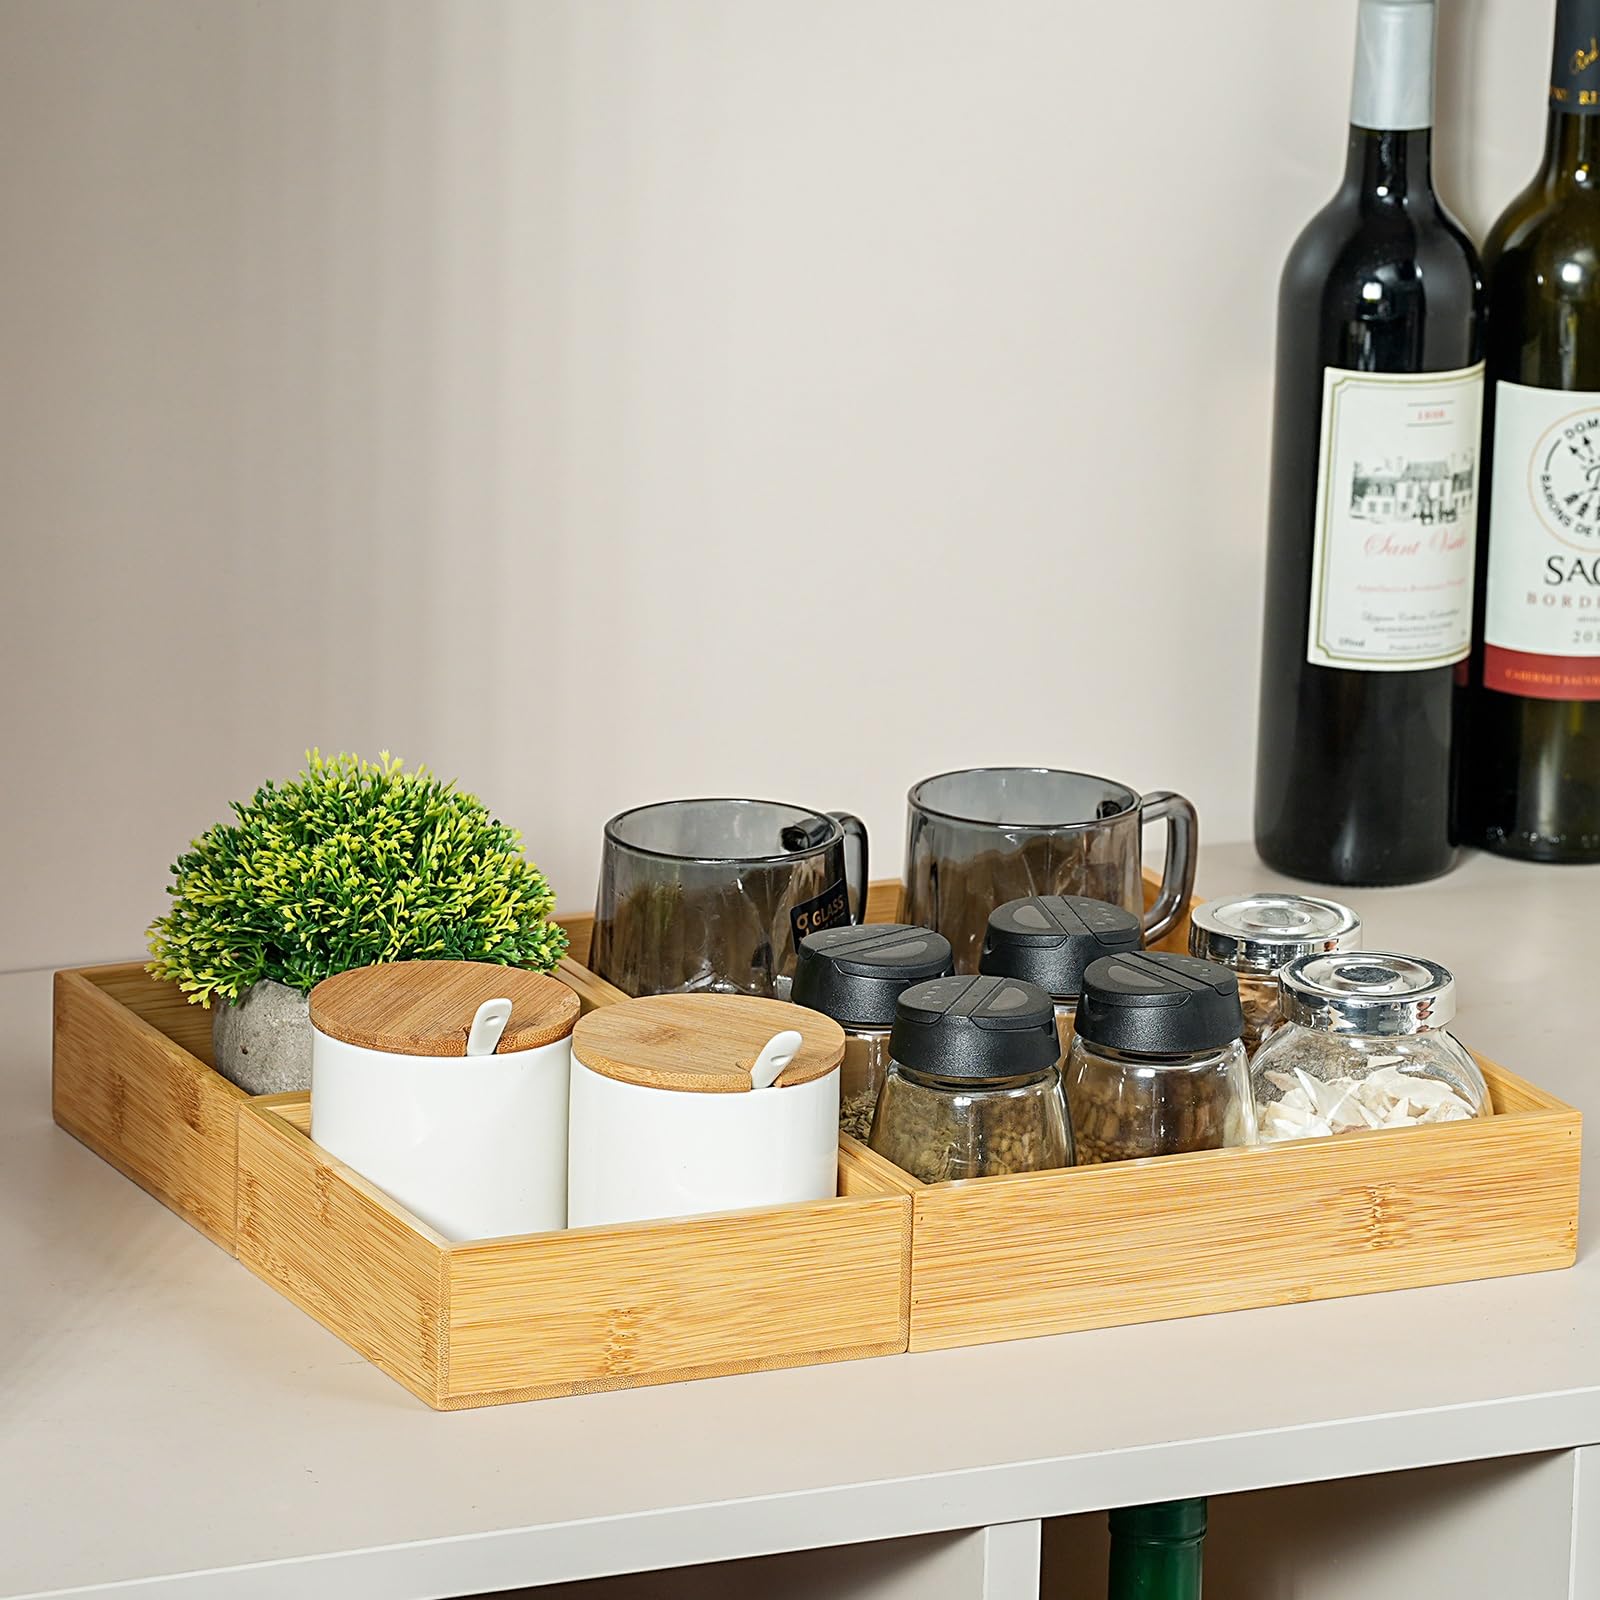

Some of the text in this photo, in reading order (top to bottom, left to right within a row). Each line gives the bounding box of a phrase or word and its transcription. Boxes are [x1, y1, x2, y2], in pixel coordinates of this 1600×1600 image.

[1540, 474, 1593, 538] BARONS DE
[812, 894, 845, 927] GLASS
